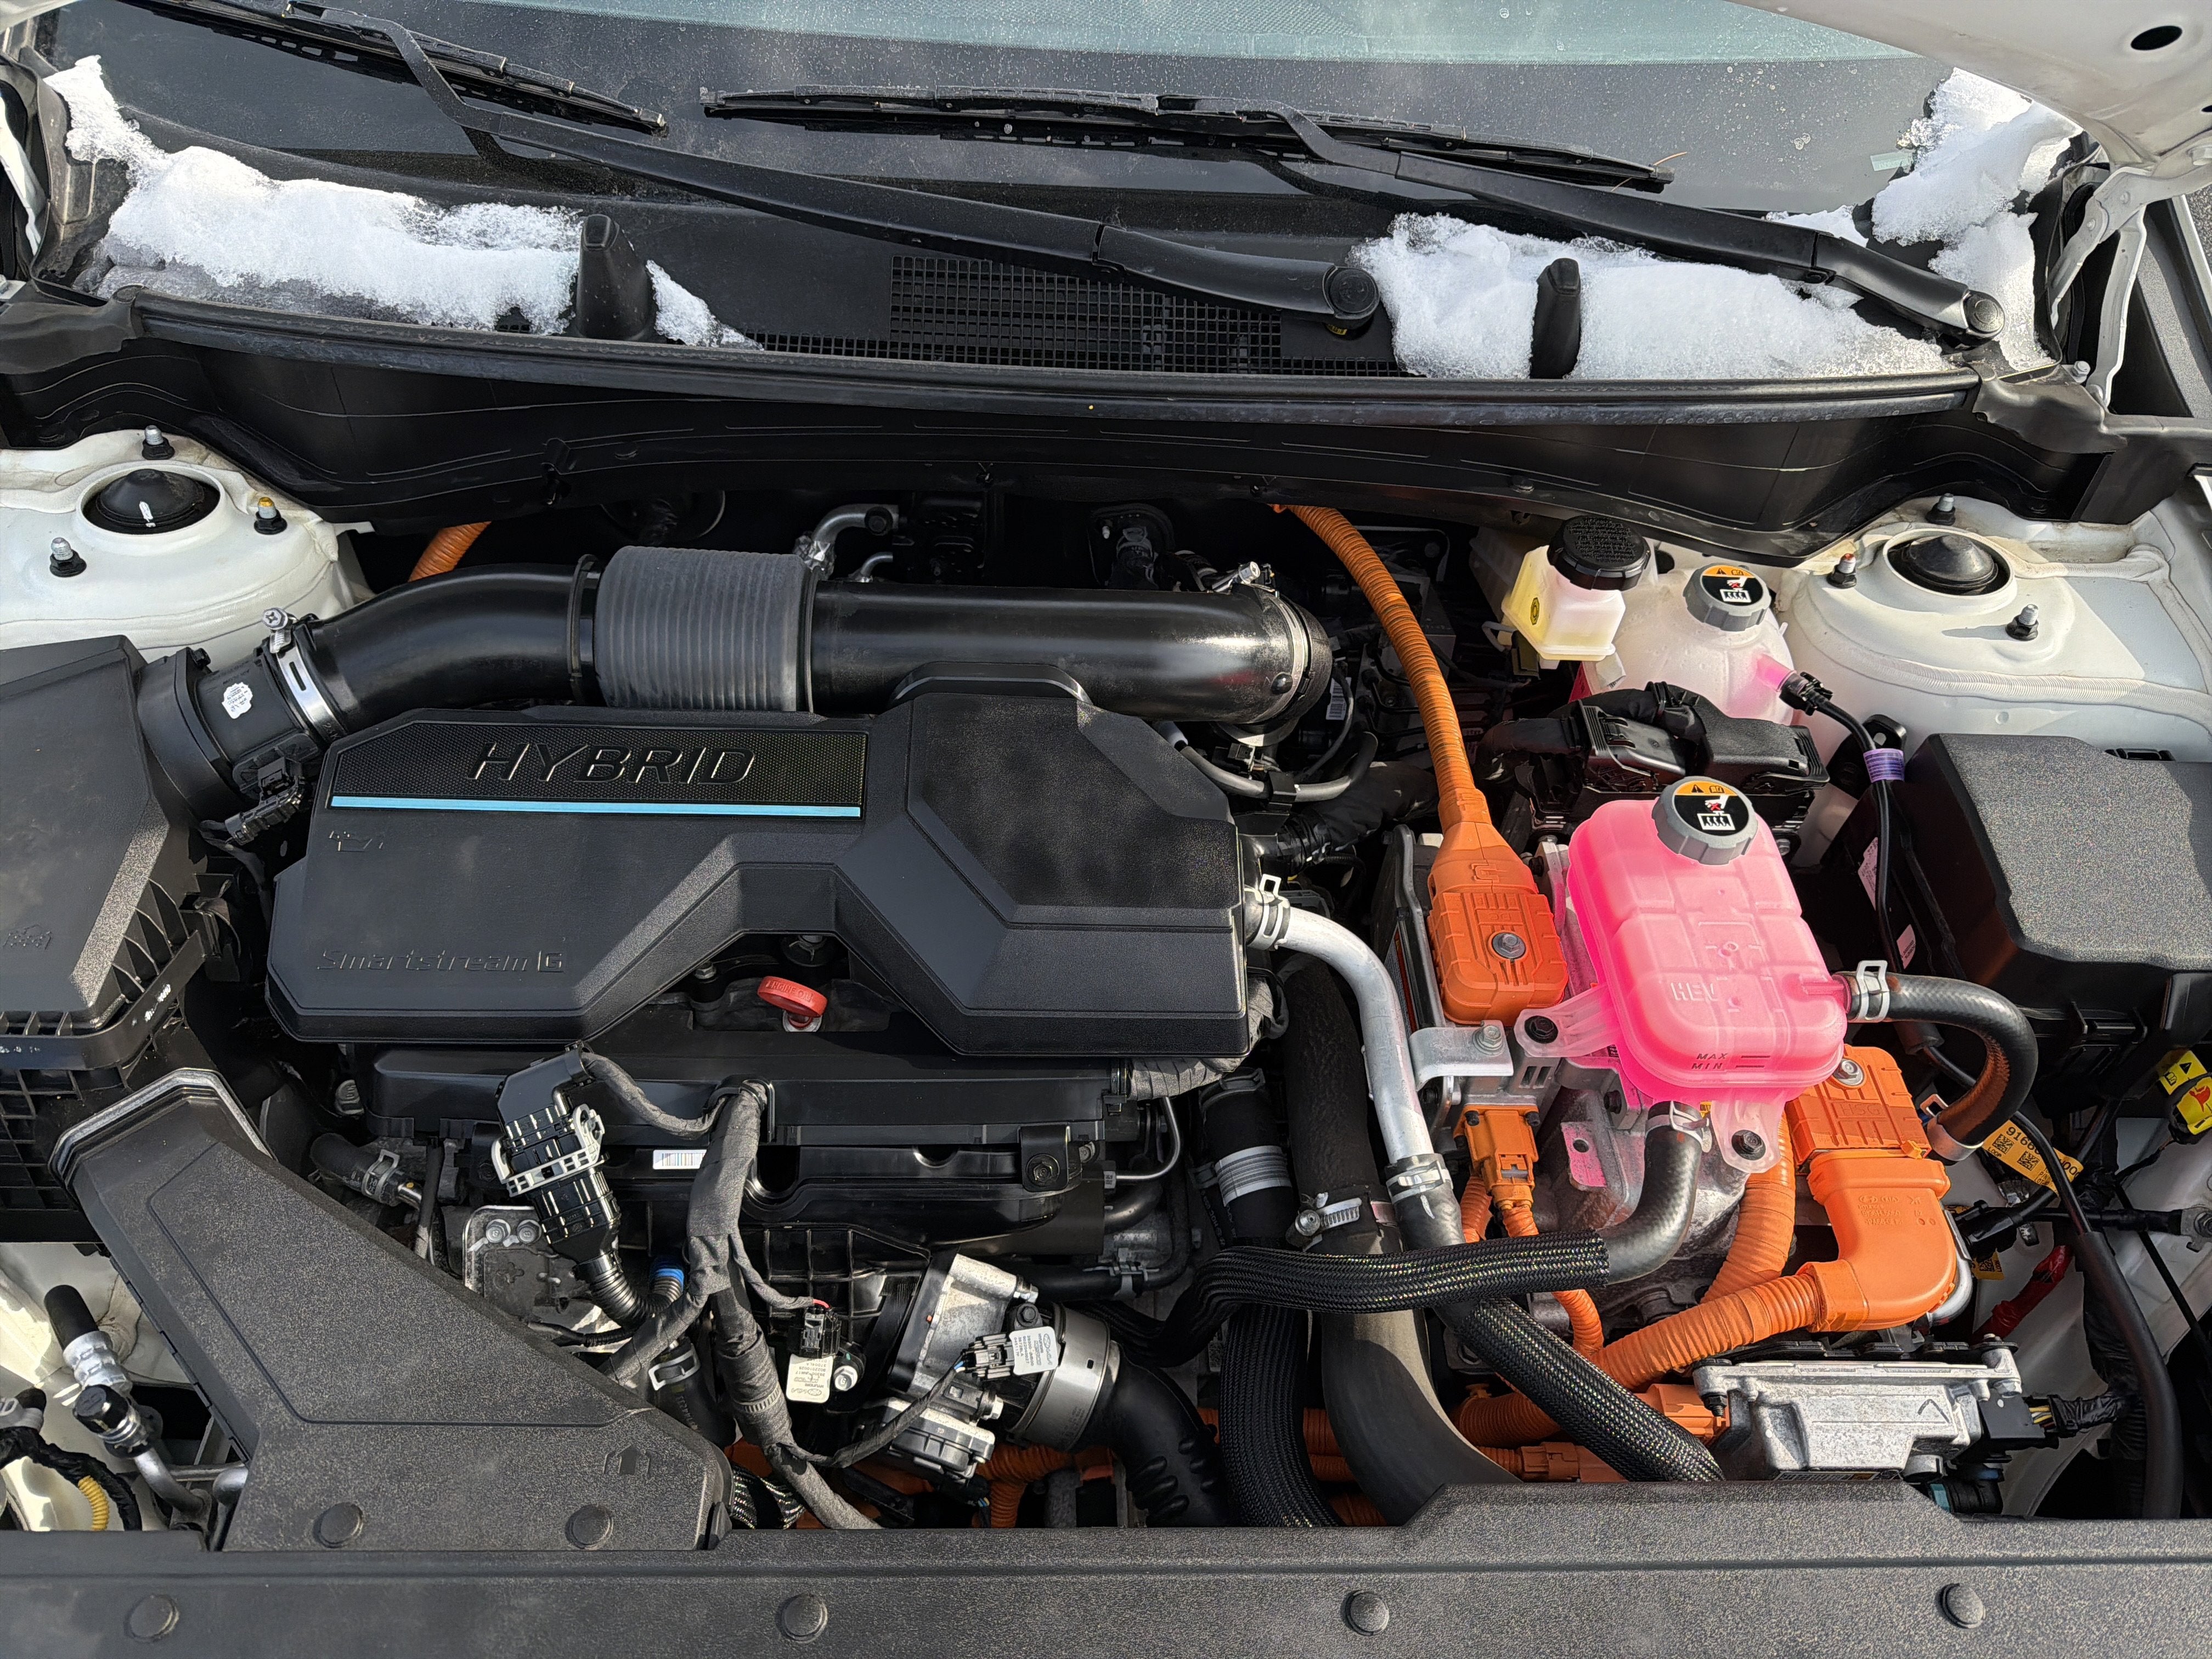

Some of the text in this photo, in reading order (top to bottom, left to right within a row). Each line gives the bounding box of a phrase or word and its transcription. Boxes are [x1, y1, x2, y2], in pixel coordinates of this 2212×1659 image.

[466, 743, 755, 785] HYBRID
[317, 950, 528, 971] Smartstream
[1988, 1146, 2002, 1156] LOOP
